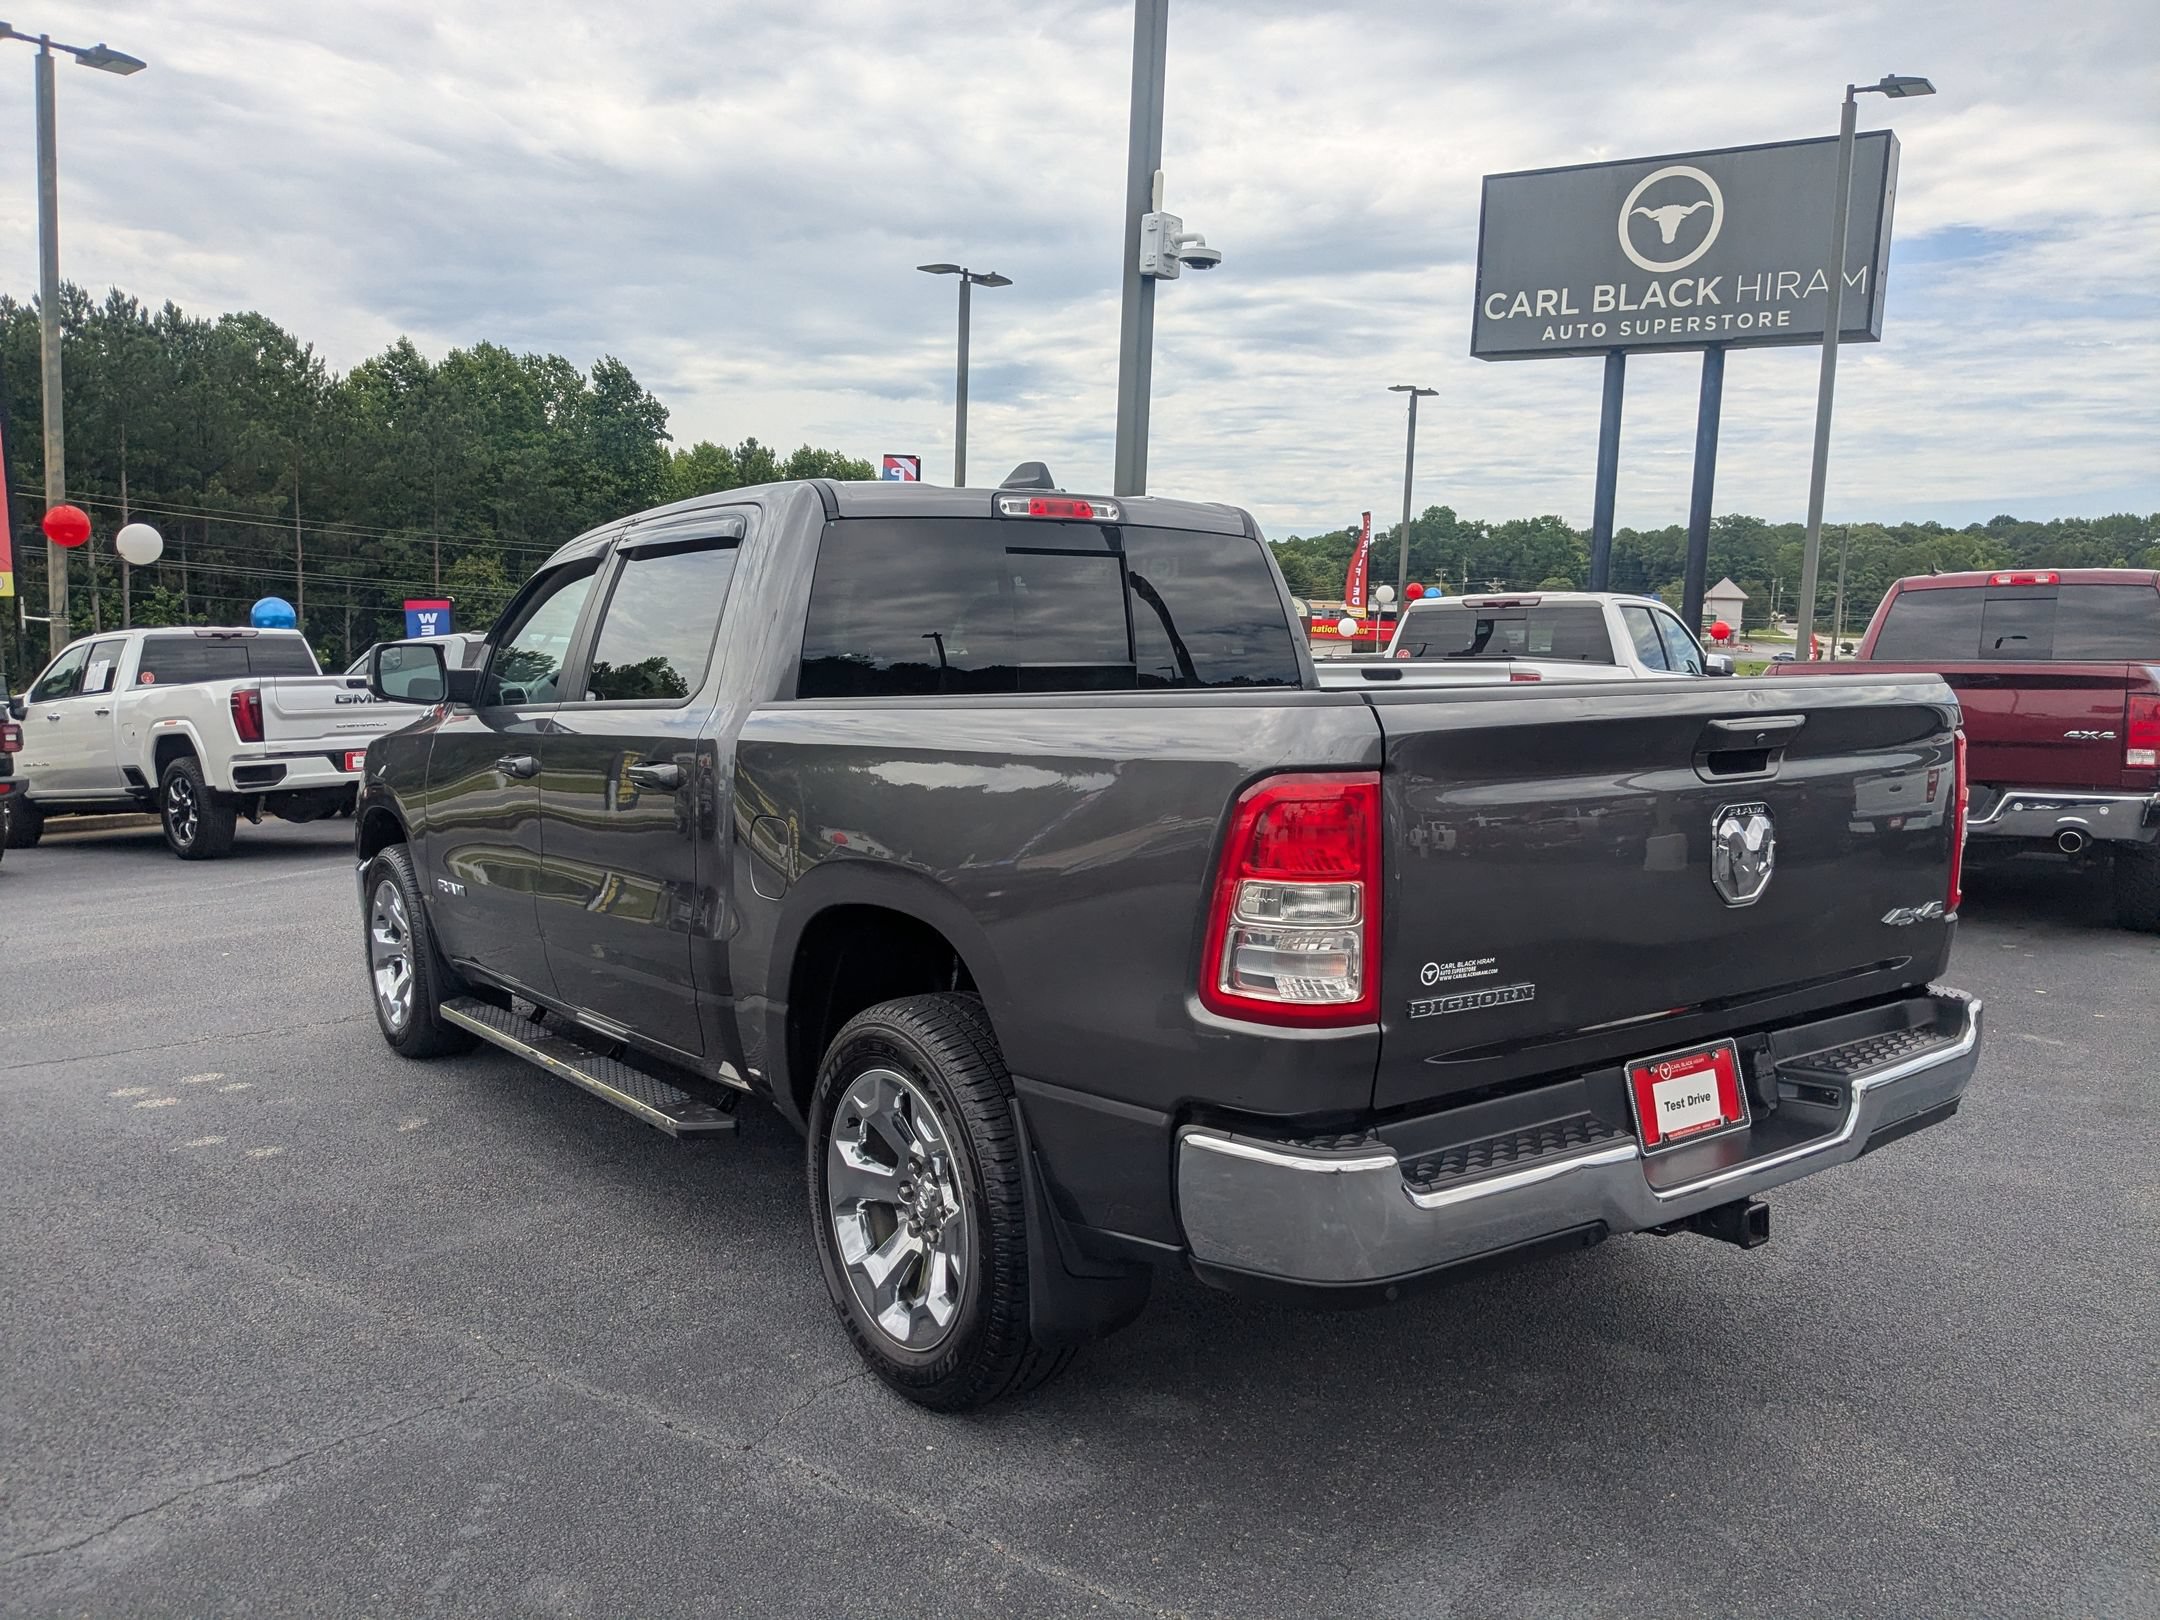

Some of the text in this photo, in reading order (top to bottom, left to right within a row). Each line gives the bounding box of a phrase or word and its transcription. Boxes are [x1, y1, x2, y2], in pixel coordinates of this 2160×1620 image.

[1483, 264, 1868, 320] CARL BLACK HIRAM
[1541, 310, 1792, 341] AUTO SUPERSTORE
[1440, 957, 1496, 970] CARL BLACK HIRAM
[1664, 1092, 1711, 1112] Test Drive
